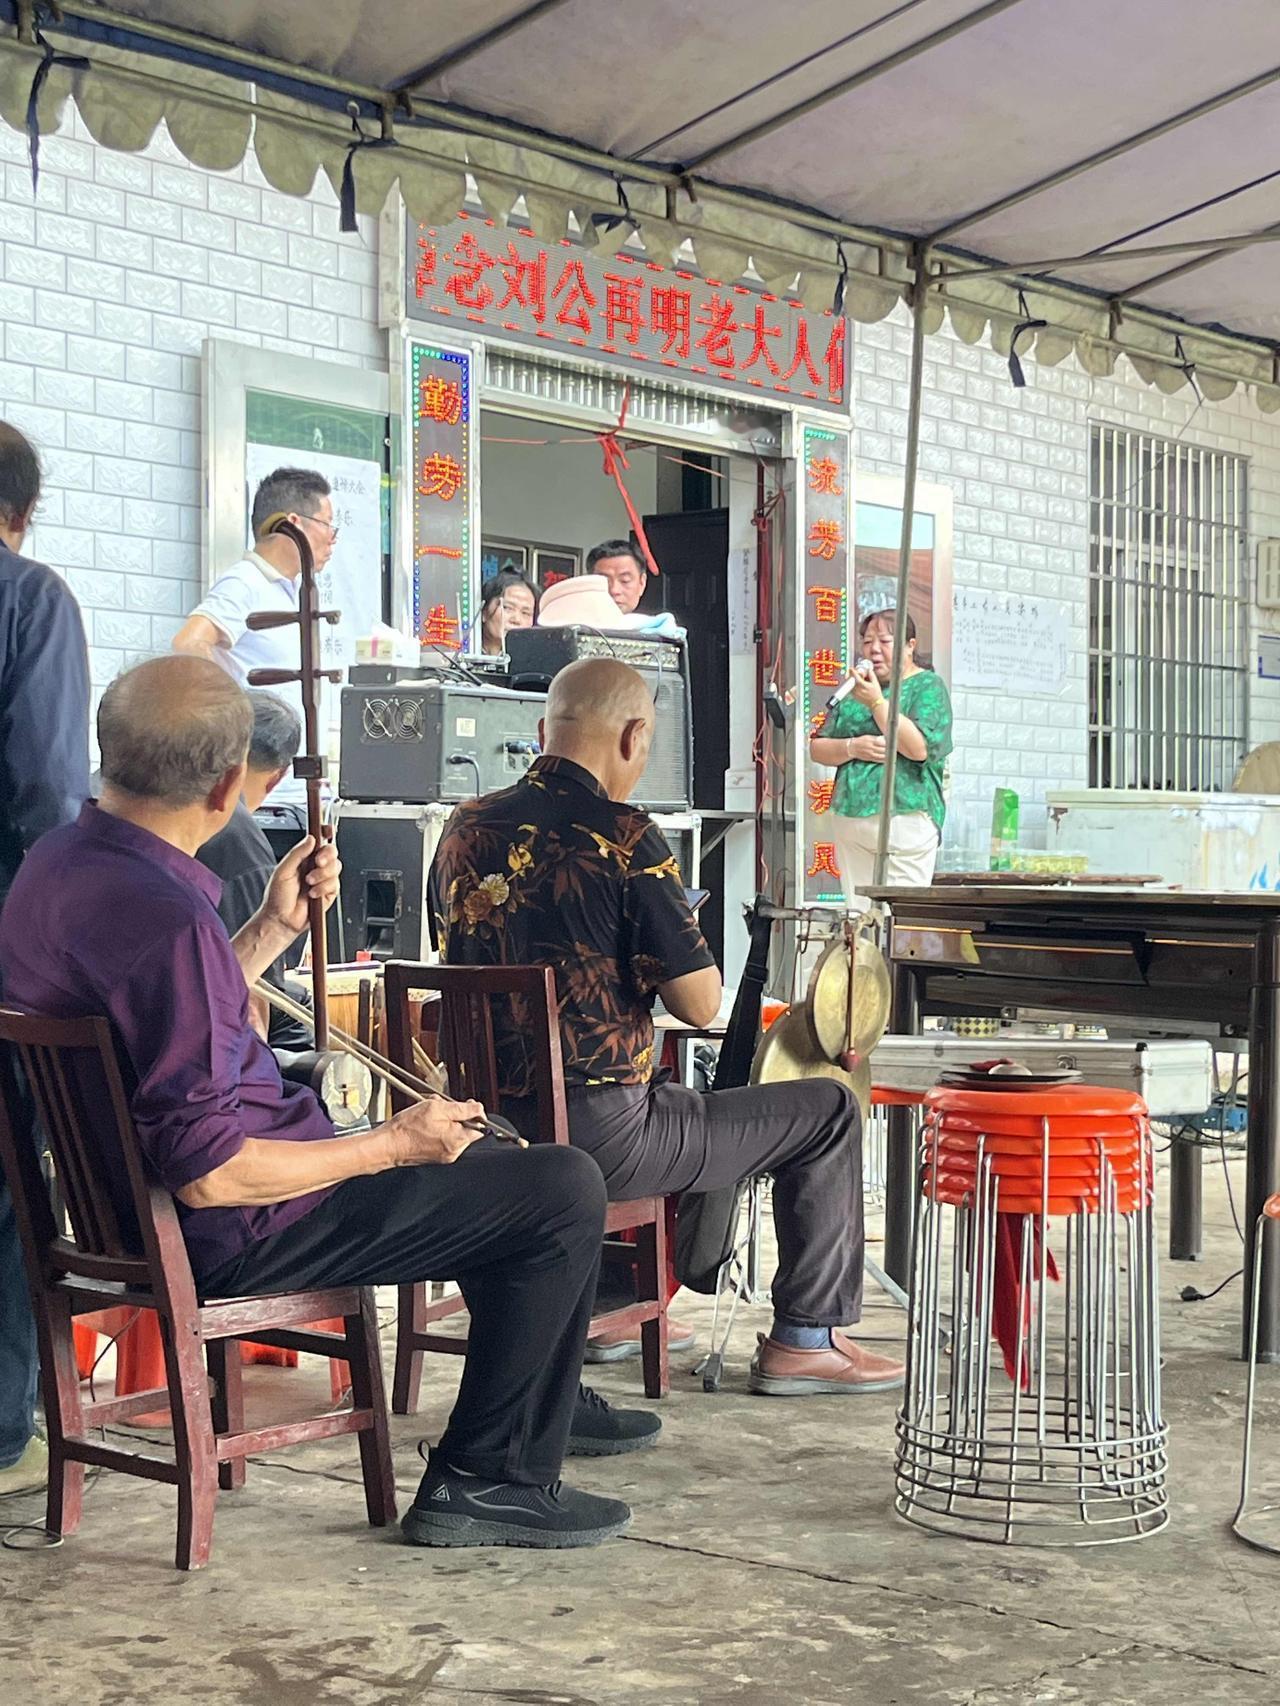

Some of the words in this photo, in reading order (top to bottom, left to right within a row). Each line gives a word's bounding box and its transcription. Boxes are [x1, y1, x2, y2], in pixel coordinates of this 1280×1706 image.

[807, 456, 845, 878] 流芳百世清风
